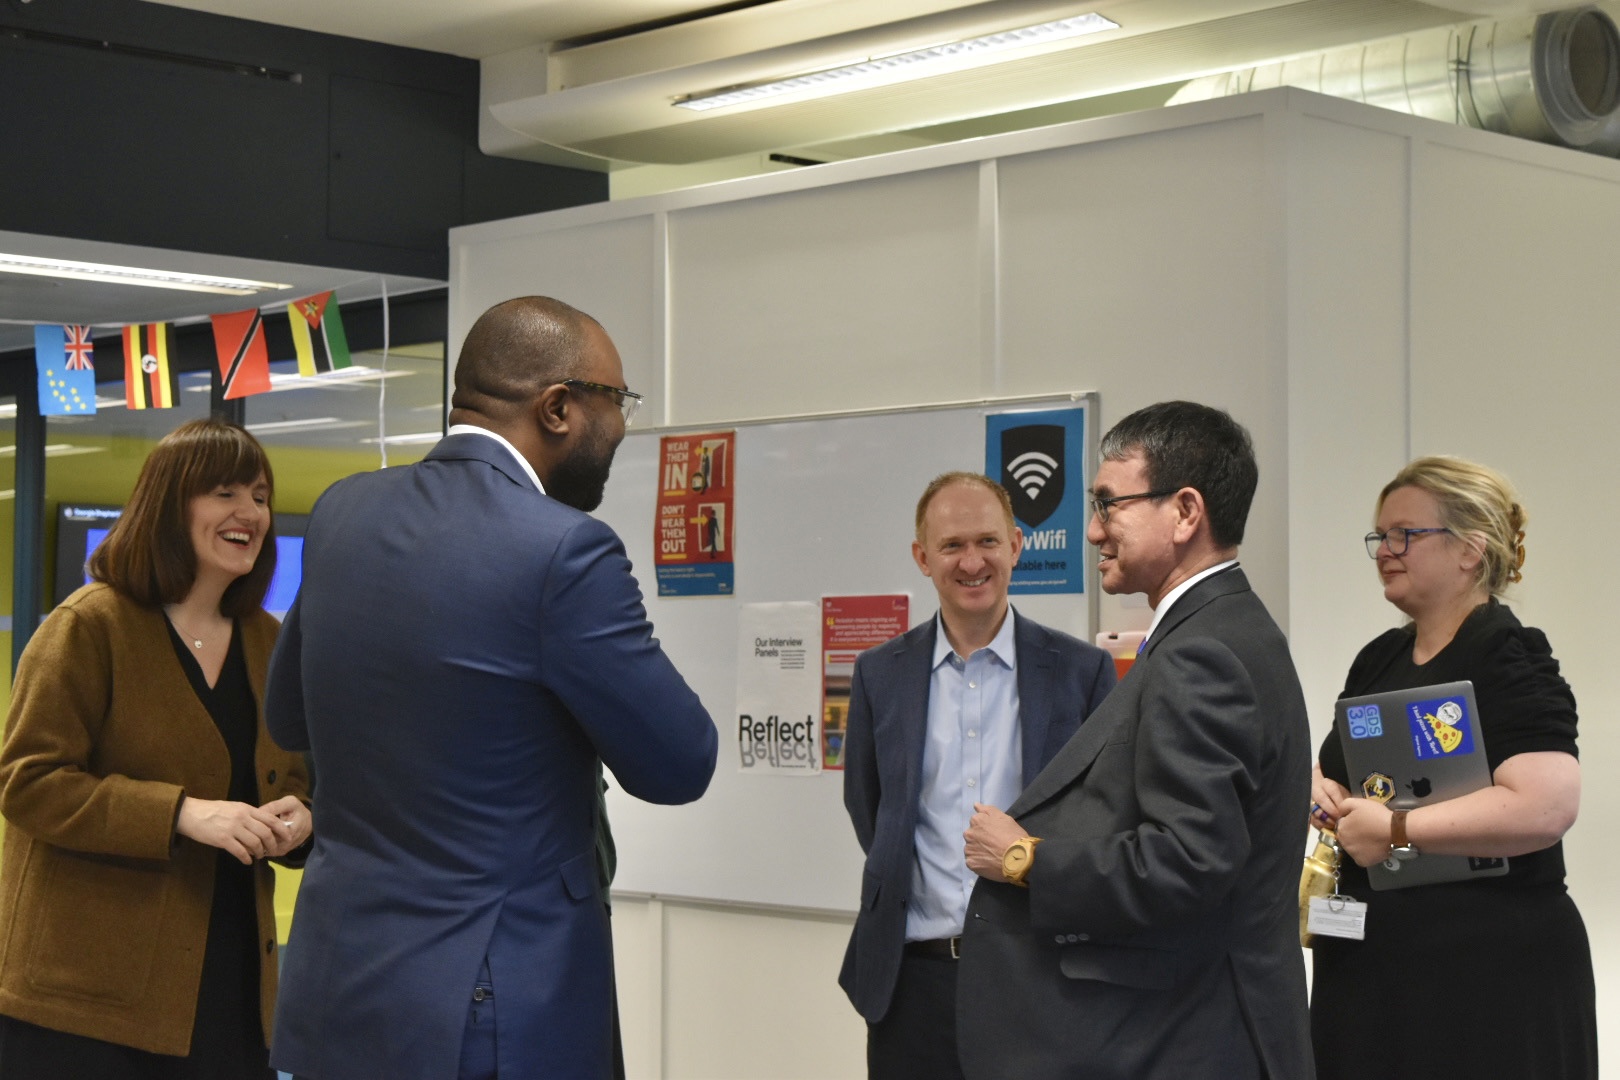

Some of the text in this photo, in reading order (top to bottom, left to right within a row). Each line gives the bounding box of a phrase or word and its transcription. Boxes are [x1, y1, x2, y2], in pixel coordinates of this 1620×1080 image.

[667, 441, 690, 452] WEAR
[666, 452, 689, 463] THEM
[664, 463, 688, 490] IN
[662, 504, 686, 516] DON'T
[661, 517, 686, 528] WEAR
[661, 528, 686, 540] THEM
[1023, 529, 1066, 550] vWifi
[661, 539, 686, 554] OUT
[1044, 560, 1067, 570] here
[755, 636, 803, 648] Our Interview
[754, 647, 779, 658] Panels
[1349, 709, 1367, 736] 3.0
[1365, 706, 1381, 736] GDS
[738, 713, 814, 744] Reflect
